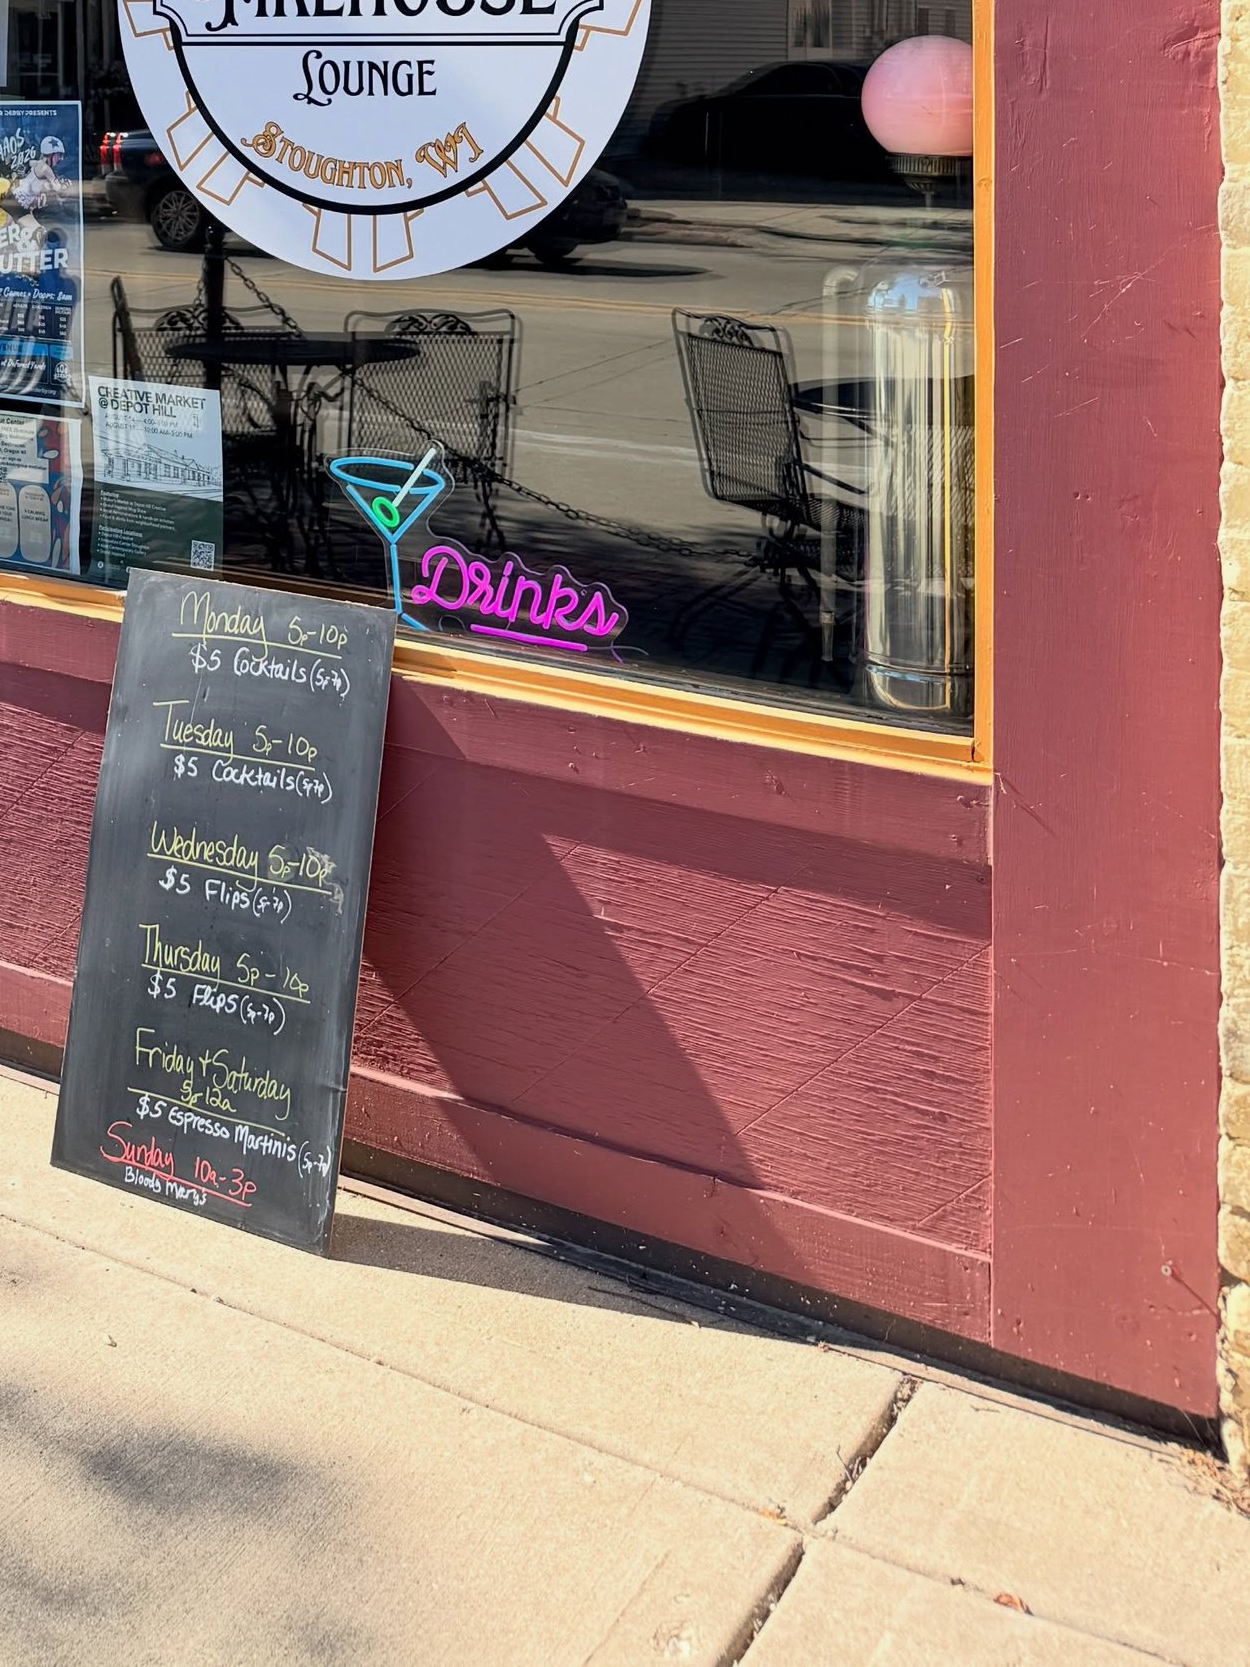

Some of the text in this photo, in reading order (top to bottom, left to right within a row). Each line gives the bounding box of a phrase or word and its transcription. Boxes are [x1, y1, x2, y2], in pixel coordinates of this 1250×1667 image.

[11, 145, 37, 169] 2026
[16, 226, 39, 255] &
[97, 386, 206, 409] CREATIVE MARKET
[99, 397, 176, 418] @ DEPOT HILL
[411, 545, 620, 637] Drinks
[181, 591, 269, 661] Monday
[190, 642, 221, 673] $5
[153, 699, 235, 763] Tuesday
[173, 753, 198, 779] $5
[151, 820, 260, 893] Wednesday
[158, 865, 191, 895] $5
[139, 923, 221, 984] Thursday
[148, 968, 177, 998] $5
[135, 1027, 195, 1080] Friday
[212, 1049, 292, 1120] Saturday
[136, 1091, 167, 1120] $5
[168, 1107, 230, 1140] Espresso
[233, 1124, 296, 1161] Martinis
[100, 1121, 174, 1177] Sunday
[124, 1165, 162, 1194] Bloody
